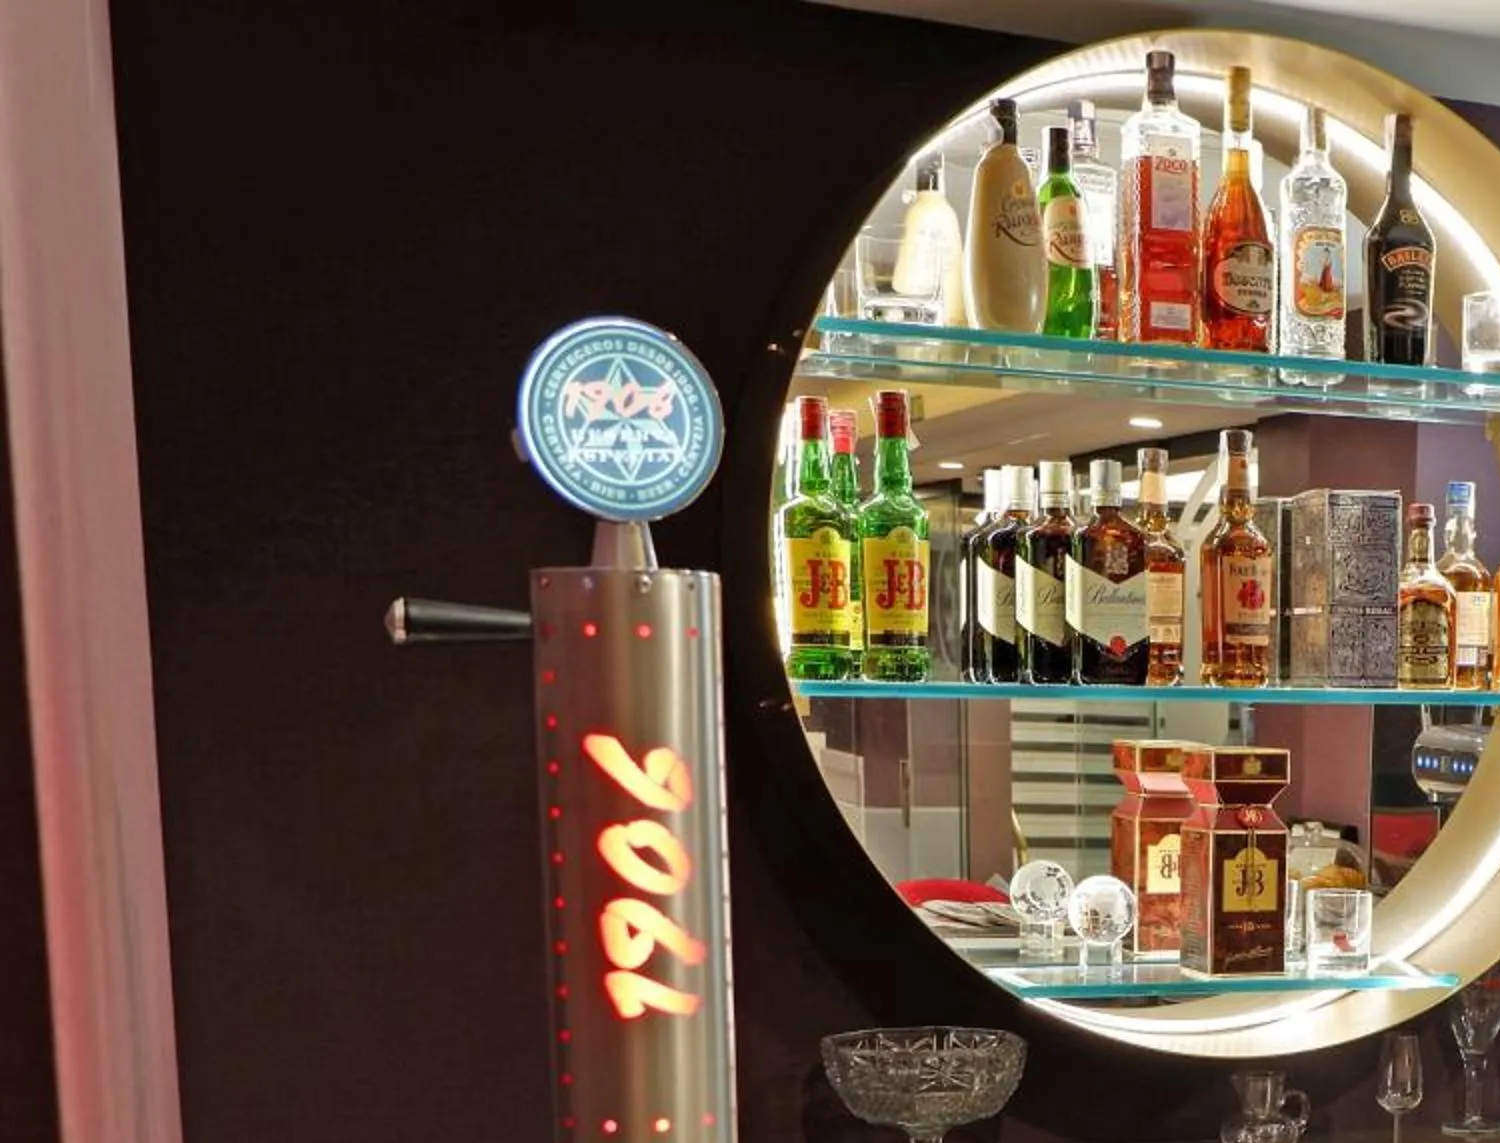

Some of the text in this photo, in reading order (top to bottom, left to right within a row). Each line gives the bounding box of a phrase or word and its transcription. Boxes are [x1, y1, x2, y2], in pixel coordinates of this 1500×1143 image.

[799, 559, 848, 609] J&B
[875, 559, 926, 610] J&B
[582, 733, 706, 1019] 1906
[1235, 867, 1265, 896] JB
